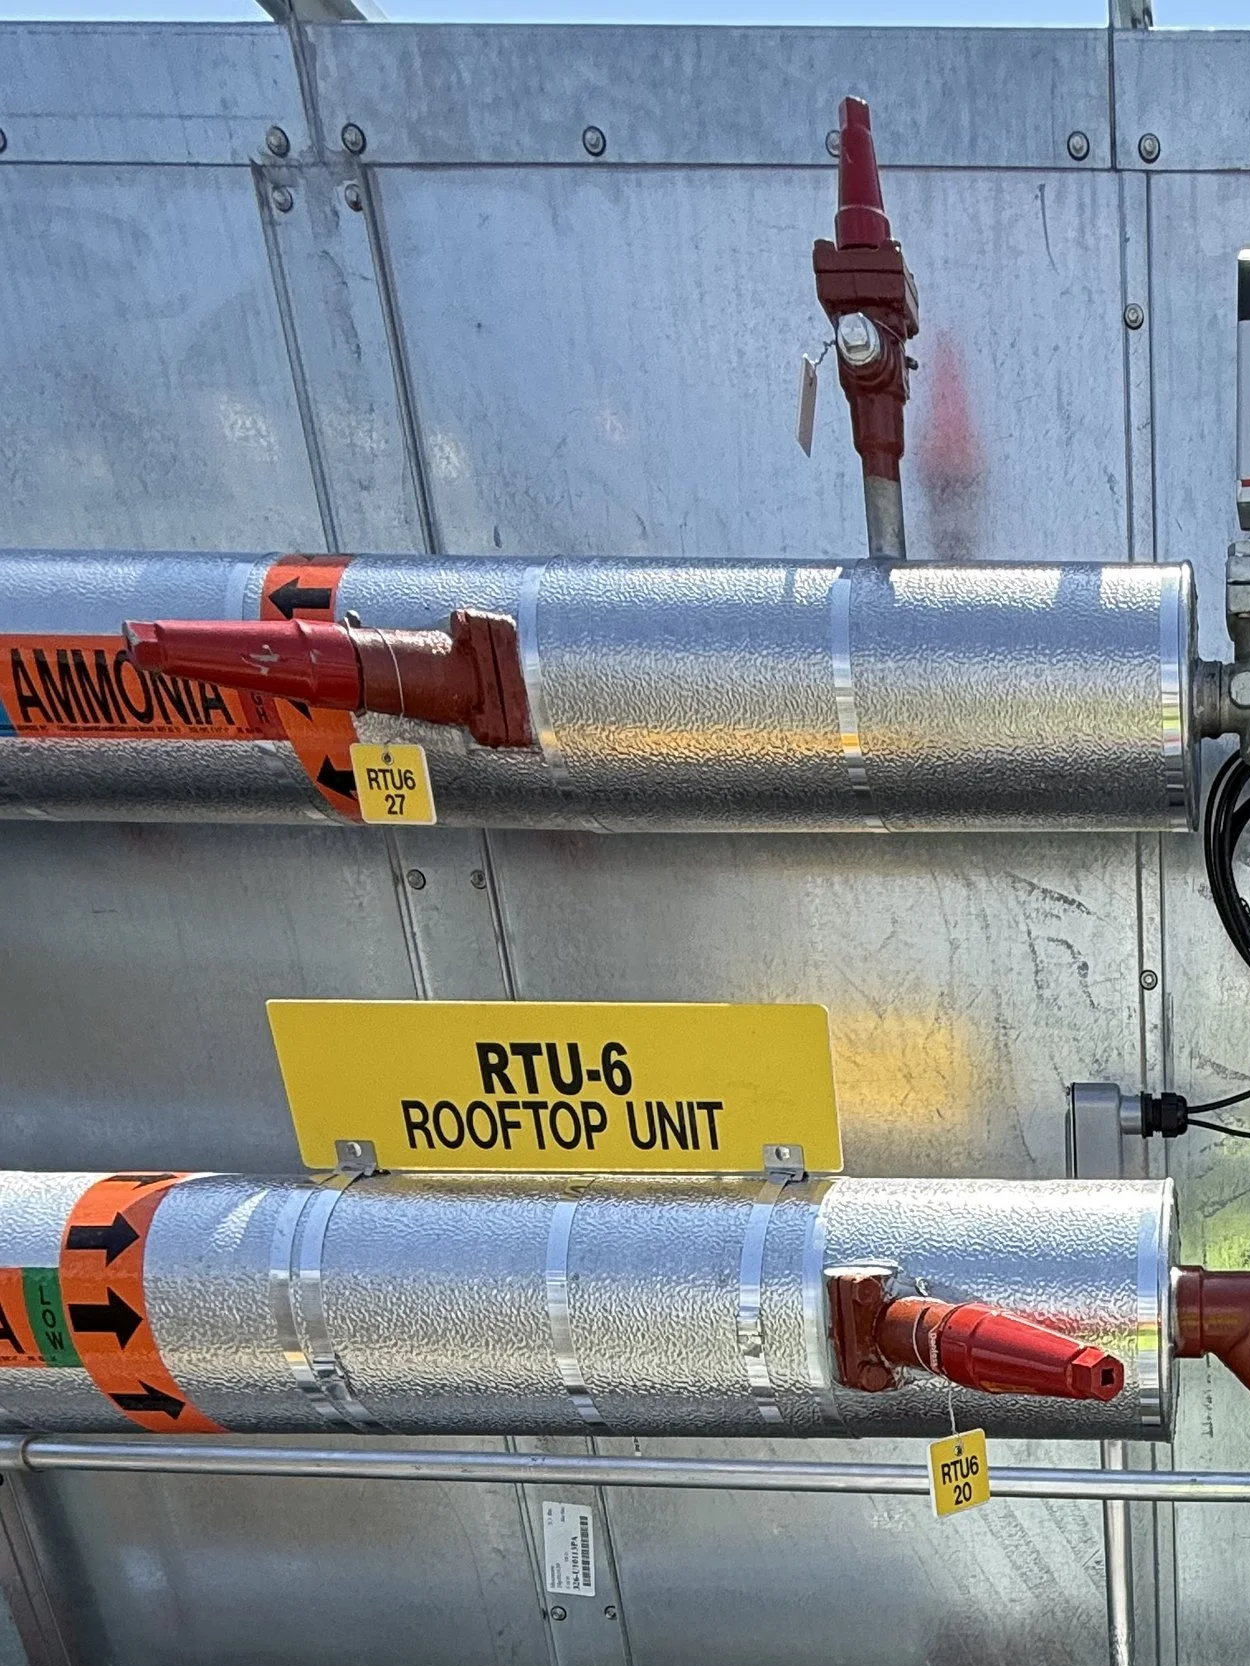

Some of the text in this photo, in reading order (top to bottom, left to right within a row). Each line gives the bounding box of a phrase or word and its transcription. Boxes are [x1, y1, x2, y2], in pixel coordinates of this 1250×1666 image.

[11, 648, 235, 726] AMMONIA
[250, 691, 271, 724] GH
[366, 768, 417, 791] RTU6
[384, 793, 406, 815] 27
[475, 1041, 633, 1096] RTU-6
[400, 1100, 724, 1151] ROOFTOP UNIT
[38, 1285, 65, 1351] LOW
[941, 1455, 980, 1486] RTU6
[953, 1482, 973, 1506] 20
